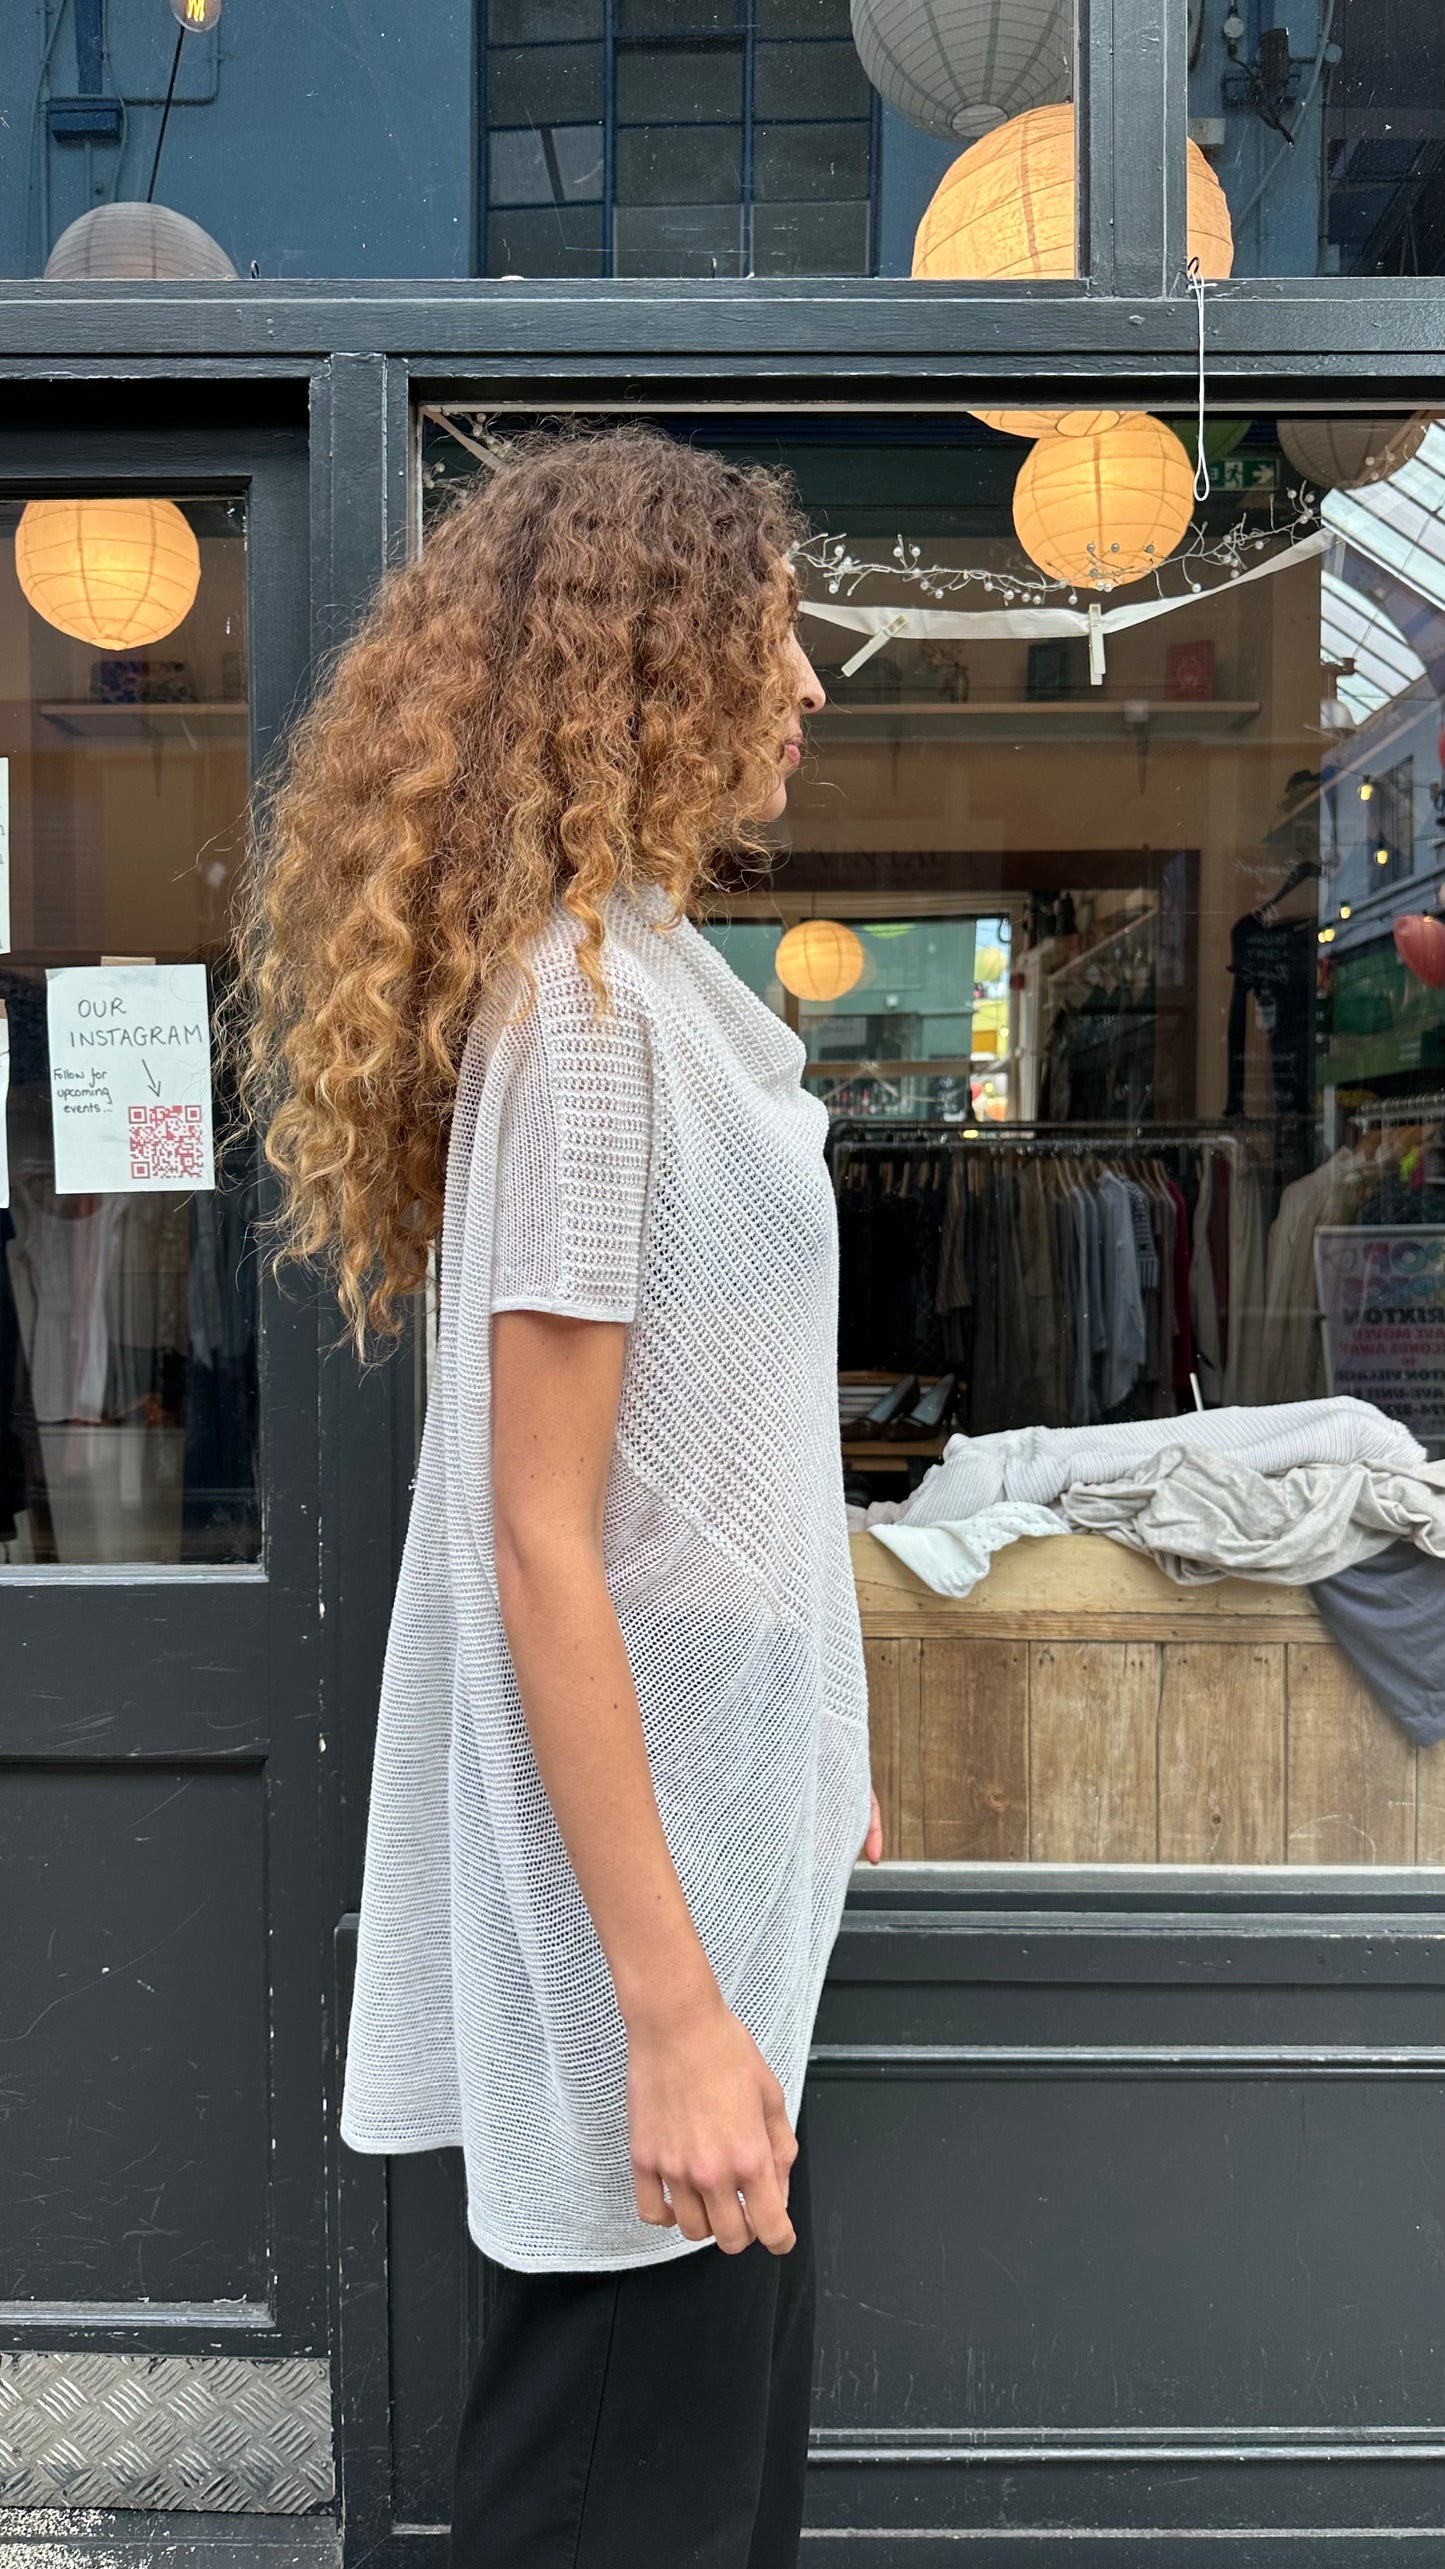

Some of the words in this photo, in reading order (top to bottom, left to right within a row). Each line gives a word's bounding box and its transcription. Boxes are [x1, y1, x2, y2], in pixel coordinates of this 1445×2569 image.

[78, 997, 127, 1018] OUR
[70, 1024, 203, 1047] INSTAGRAM
[53, 1067, 85, 1080] Follow
[89, 1067, 108, 1088] for
[57, 1087, 113, 1105] upcoming
